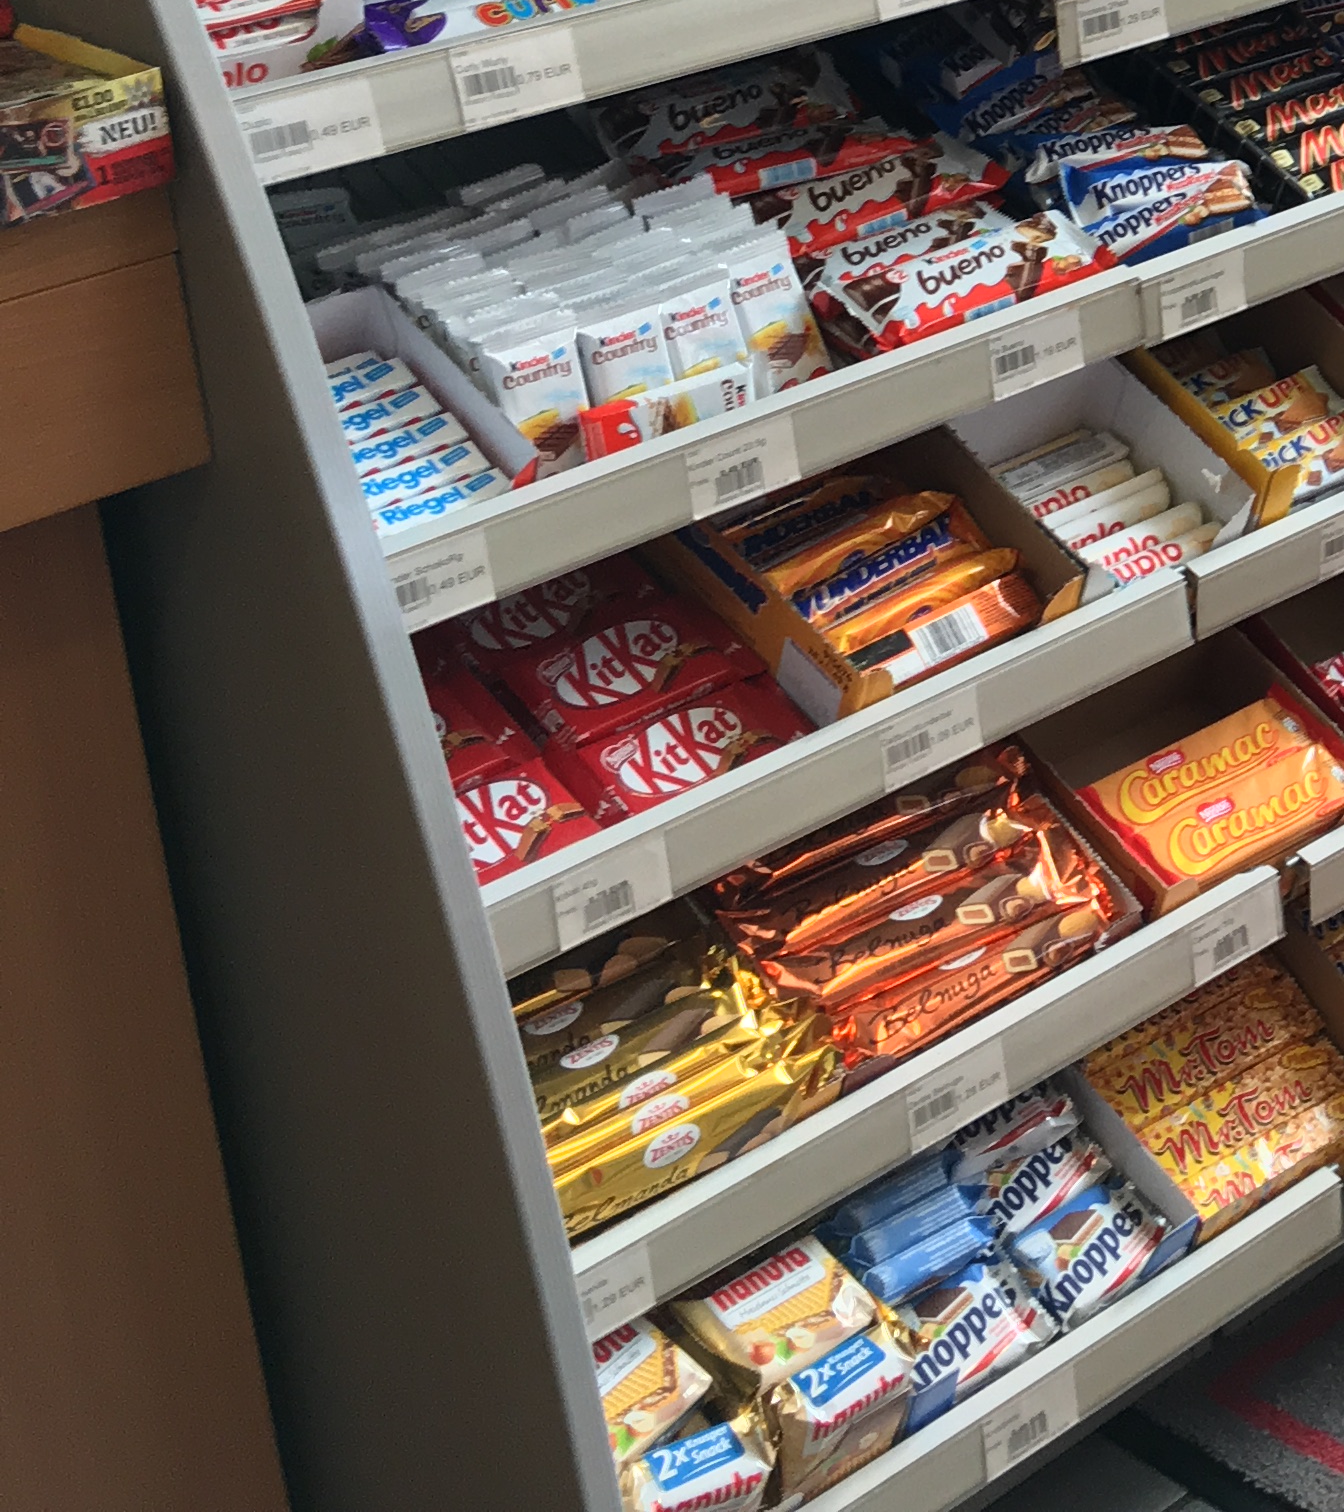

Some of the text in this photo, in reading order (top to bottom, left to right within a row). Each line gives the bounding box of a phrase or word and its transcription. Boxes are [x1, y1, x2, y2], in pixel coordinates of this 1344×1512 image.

[101, 113, 159, 145] NEU!
[668, 85, 764, 130] bueno
[1046, 123, 1151, 163] Knoppers
[808, 155, 896, 213] bueno
[1095, 164, 1201, 209] Knoppers
[916, 243, 1005, 294] bueno
[925, 244, 969, 264] Kinder
[664, 309, 729, 343] Country
[671, 304, 707, 328] Kinder
[503, 357, 572, 392] Country
[510, 354, 551, 377] Kinder
[381, 488, 466, 527] Riegel
[560, 619, 679, 710] KitKat
[619, 704, 742, 796] KitKat
[1119, 720, 1277, 818] Caramac
[1168, 770, 1323, 876] Caramac
[1128, 1016, 1274, 1111] Mr.Tom
[650, 1133, 693, 1166] ZENTIS
[713, 1250, 810, 1310] hanuta
[1047, 1203, 1142, 1320] Knoppers
[803, 1337, 865, 1391] 2x Knusper
[836, 1345, 873, 1375] Snack
